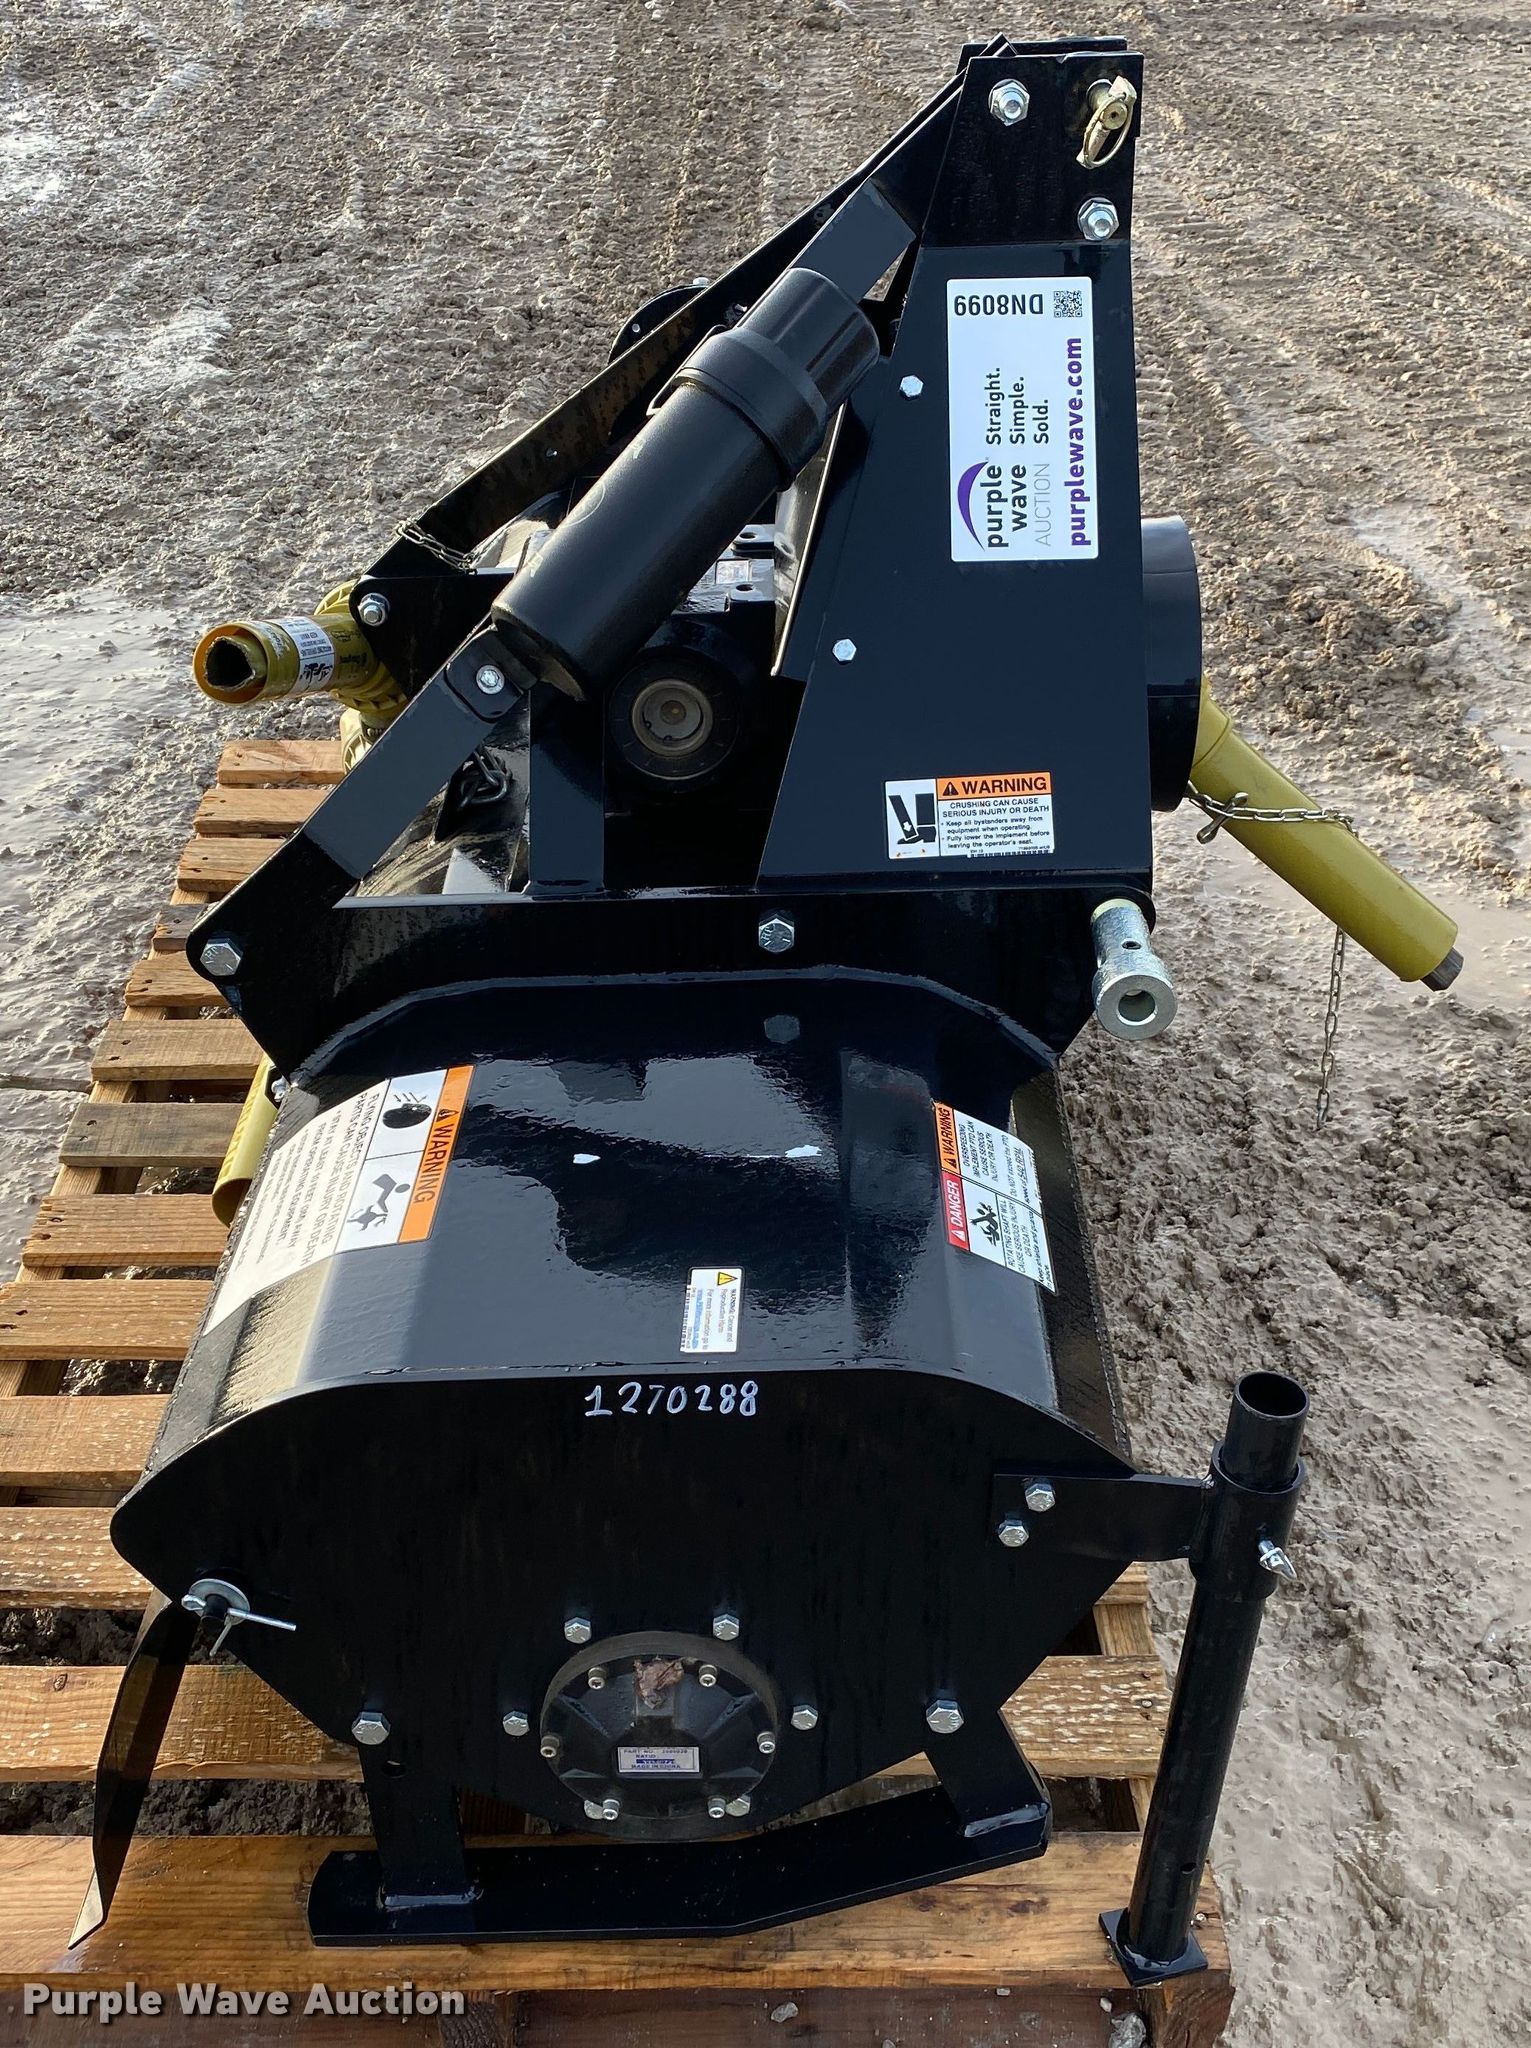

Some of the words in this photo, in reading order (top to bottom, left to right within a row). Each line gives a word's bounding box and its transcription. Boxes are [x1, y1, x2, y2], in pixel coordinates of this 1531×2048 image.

[954, 294, 1044, 316] DN8099
[984, 367, 1005, 445] Straight.
[1008, 376, 1029, 444] Simple.
[1032, 400, 1049, 444] Sold.
[1064, 338, 1091, 546] purplewave.com
[980, 465, 1009, 547] purple
[1011, 464, 1027, 532] wave
[1033, 463, 1051, 547] AUCTION
[950, 800, 991, 809] CRUSHING
[993, 799, 1010, 807] CAN
[1012, 798, 1039, 806] CAUSE
[962, 776, 1047, 795] WARNING
[942, 810, 977, 818] SERIOUS
[980, 808, 1007, 816] INJURY
[1023, 805, 1050, 813] DEATH
[946, 820, 962, 828] Keep
[974, 818, 1008, 826] bystanders
[948, 842, 970, 850] leaving
[985, 840, 1016, 848] operator's
[996, 831, 1028, 839] implement
[349, 1091, 367, 1122] PARTS
[360, 1092, 380, 1127] FLYING
[342, 1121, 358, 1142] CAN
[345, 1125, 369, 1170] OBJECTS
[939, 1108, 955, 1155] WARNING
[330, 1141, 351, 1177] CAUSE
[414, 1123, 453, 1203] WARNING
[318, 1174, 339, 1213] INJURY
[338, 1169, 353, 1193] AND
[312, 1211, 327, 1230] OR
[320, 1190, 347, 1245] ROTATING
[947, 1181, 964, 1228] DANGER
[299, 1228, 321, 1267] DEATH
[584, 1380, 759, 1417] 1270288
